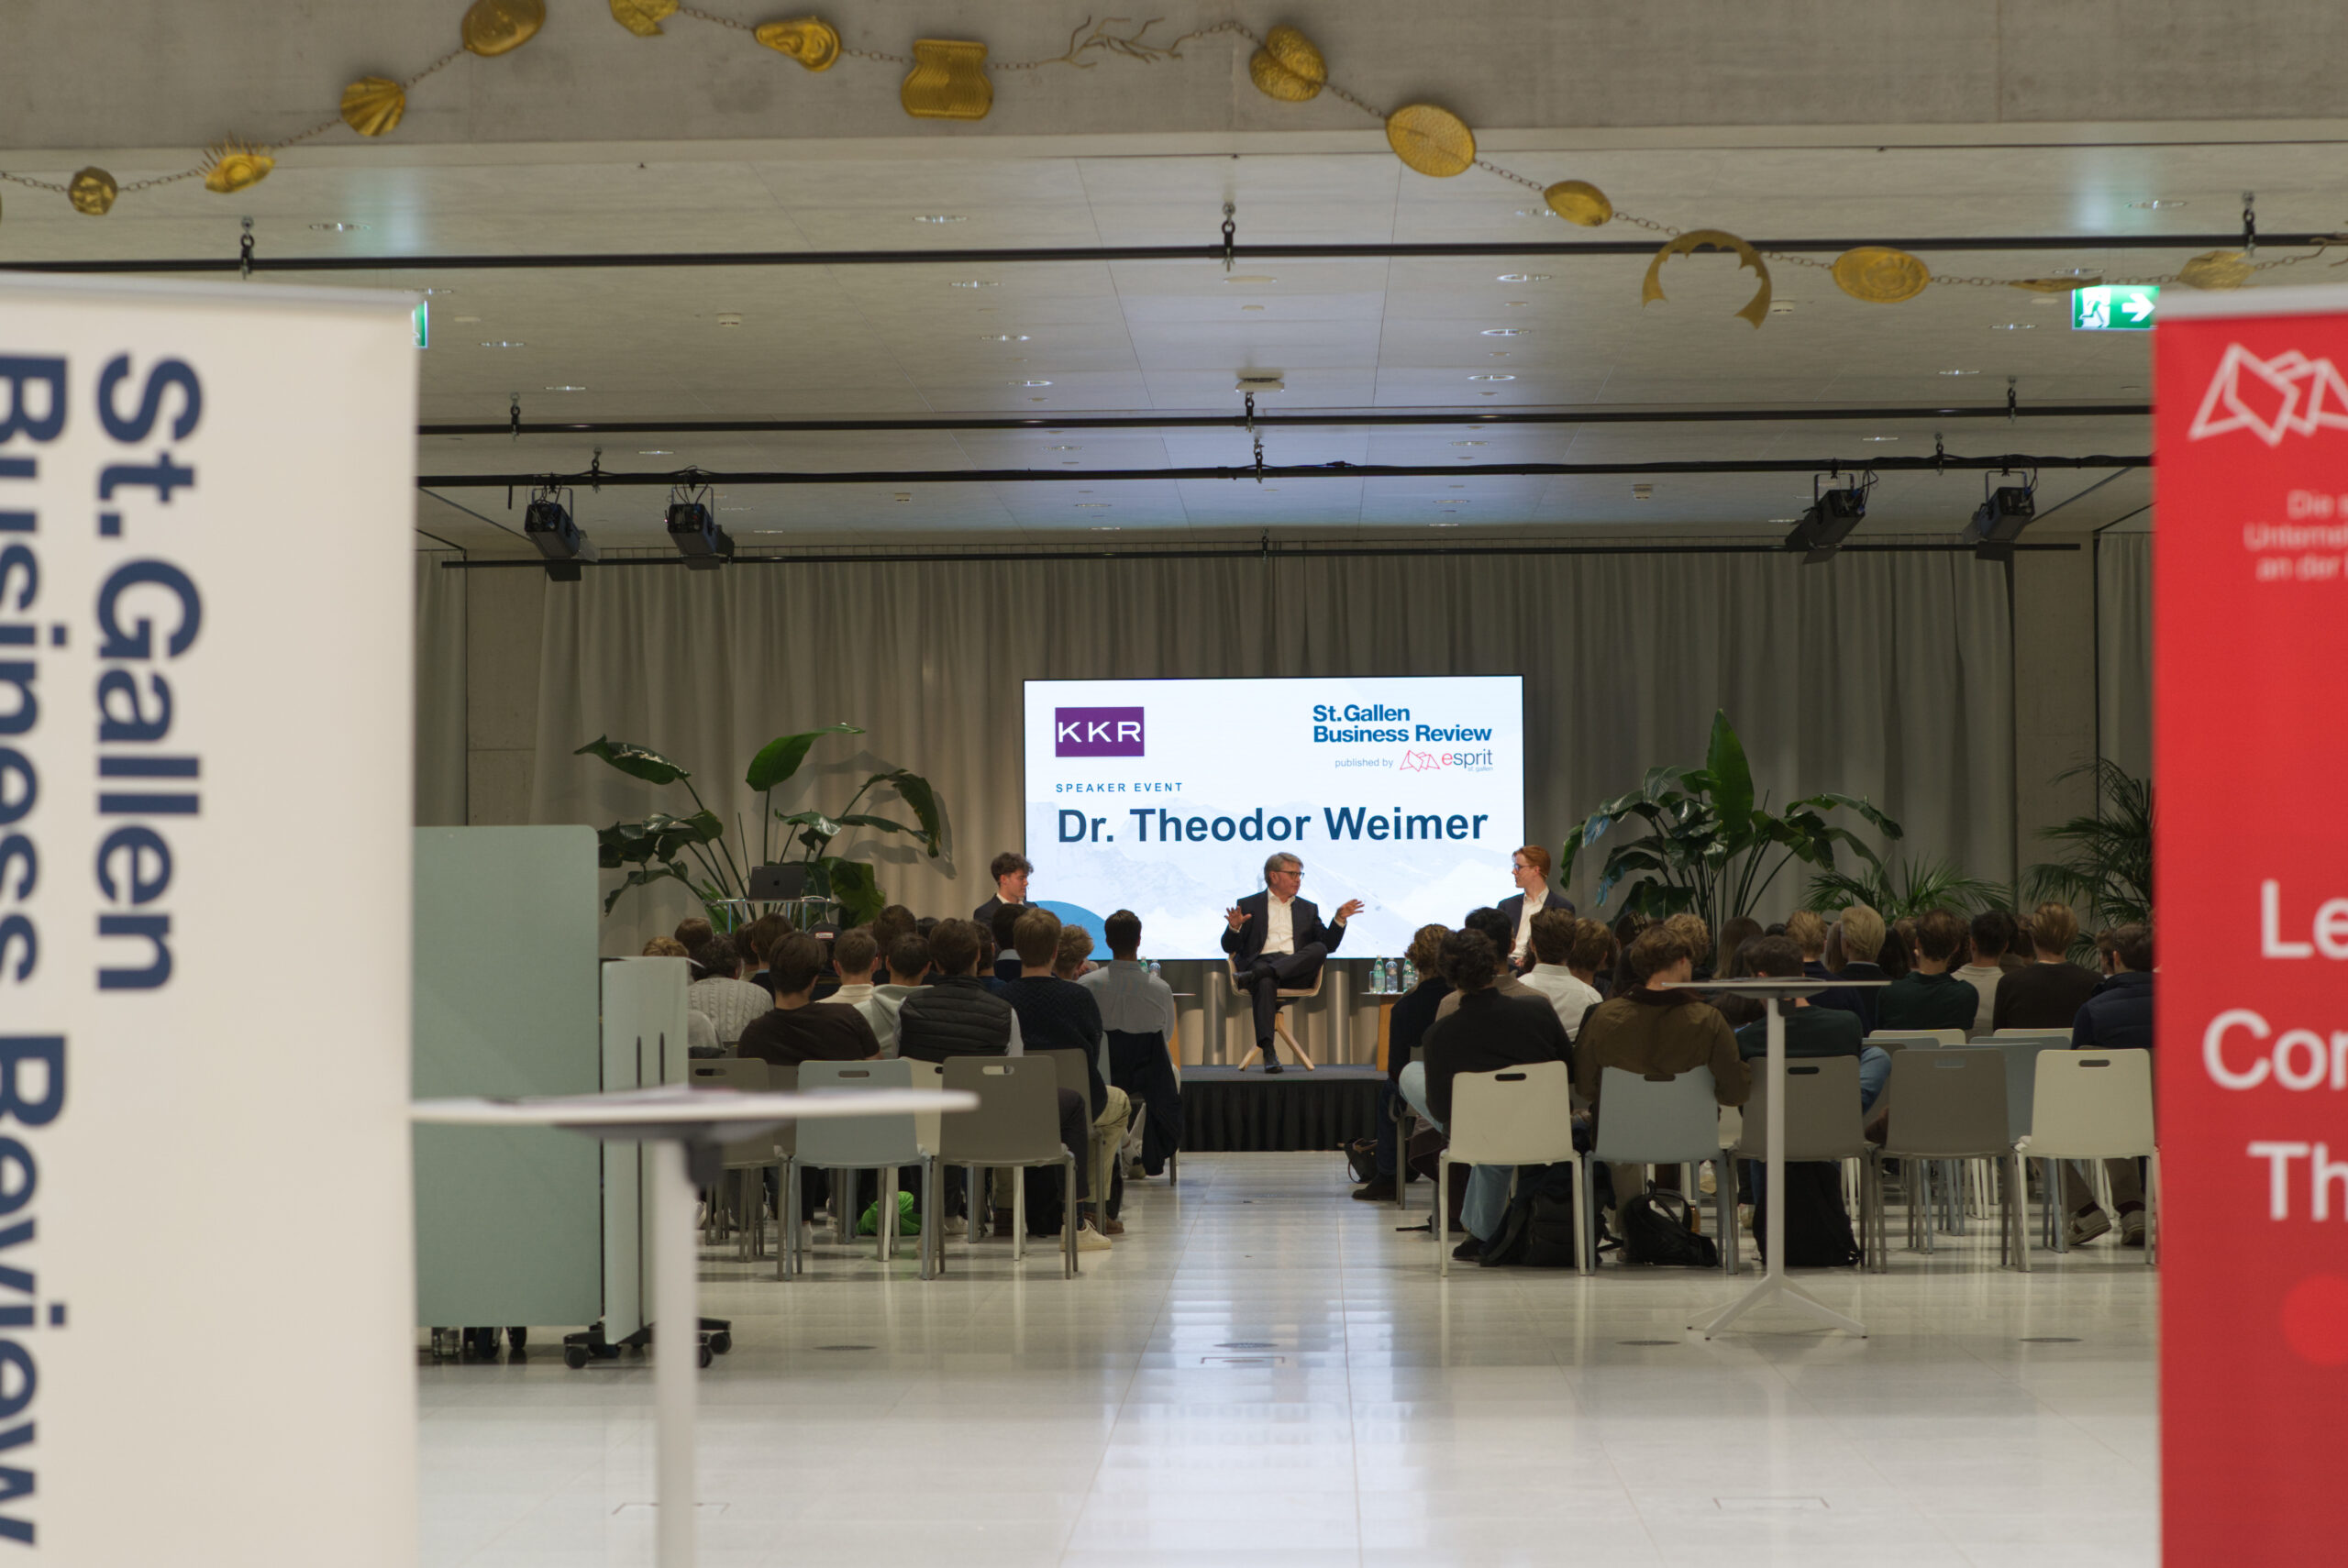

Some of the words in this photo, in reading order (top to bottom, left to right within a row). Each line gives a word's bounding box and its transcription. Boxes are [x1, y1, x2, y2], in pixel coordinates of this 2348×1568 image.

[2287, 490, 2335, 520] Die
[2256, 556, 2293, 581] an
[2295, 552, 2341, 581] der
[1058, 721, 1142, 743] KKR
[1313, 724, 1410, 743] Business
[1415, 723, 1492, 742] Review
[1335, 757, 1379, 769] published
[1382, 757, 1394, 769] by
[1441, 748, 1493, 768] esprit
[1056, 783, 1126, 793] SPEAKER
[1134, 782, 1182, 792] EVENT
[1058, 809, 1113, 843] Dr.
[1129, 807, 1312, 843] Theodor
[1324, 806, 1489, 841] Weimer
